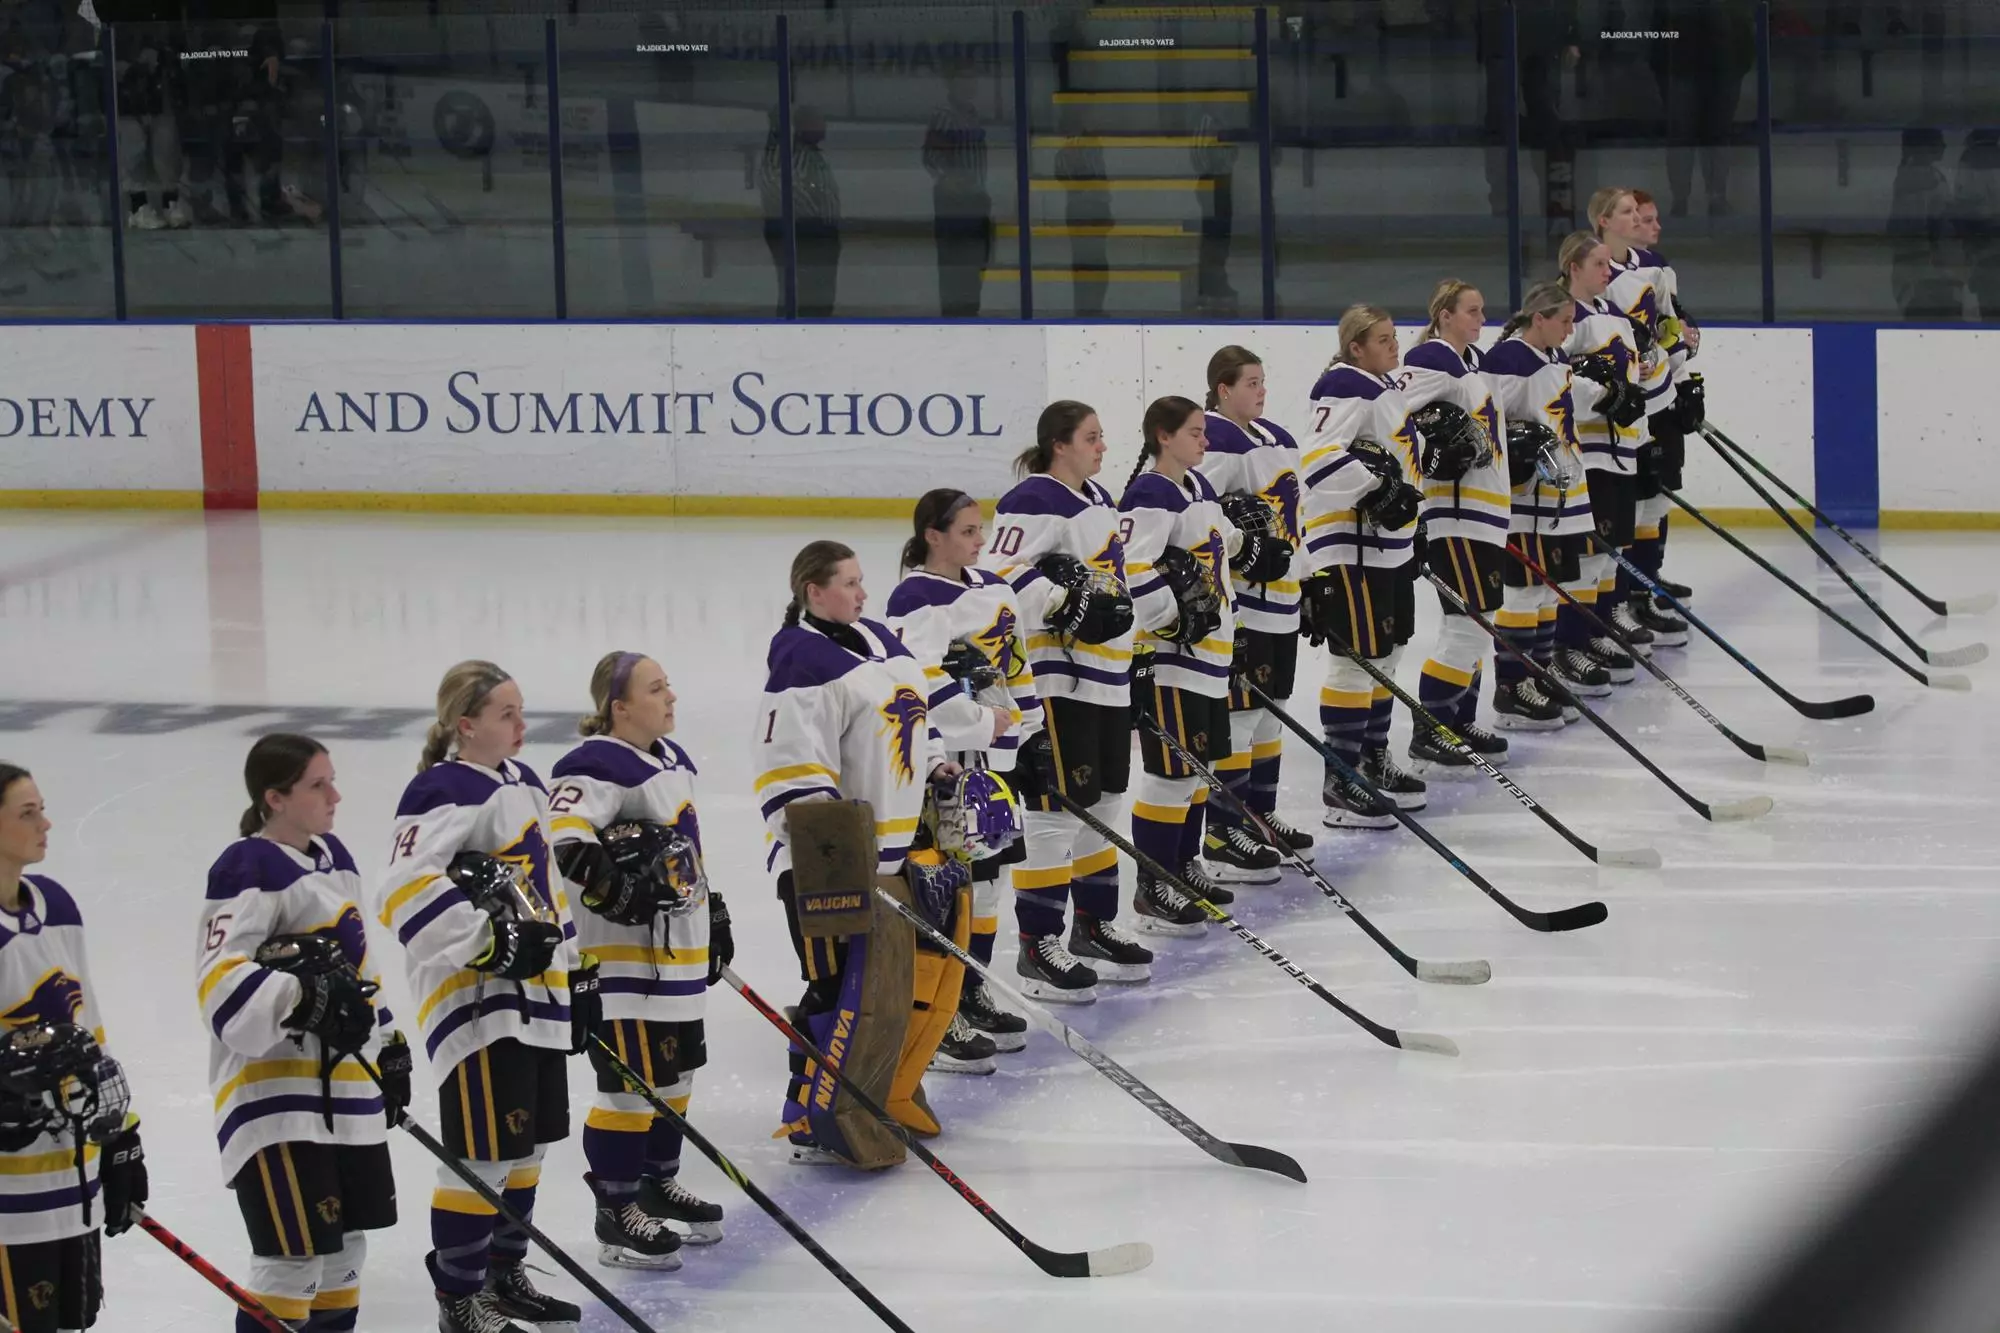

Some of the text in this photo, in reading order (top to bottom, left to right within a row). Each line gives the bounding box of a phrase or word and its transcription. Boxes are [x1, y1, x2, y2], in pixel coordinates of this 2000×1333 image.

[0, 371, 1003, 437] DEMY AND SUMMIT SCHOOL
[1314, 406, 1331, 433] 7
[989, 526, 1025, 557] 10
[1119, 517, 1135, 545] 9
[1613, 556, 1657, 588] BAUER
[1663, 678, 1721, 727] BAUER
[763, 708, 778, 744] 1
[548, 785, 583, 813] 12
[1467, 751, 1537, 808] BAUER
[389, 824, 420, 867] 14
[1284, 848, 1353, 914] CCM
[805, 893, 862, 912] VAUGHN
[206, 913, 233, 951] 15
[1236, 922, 1319, 988] BAUER
[815, 1007, 855, 1111] VAUHN
[931, 1157, 993, 1216] VAPOR
